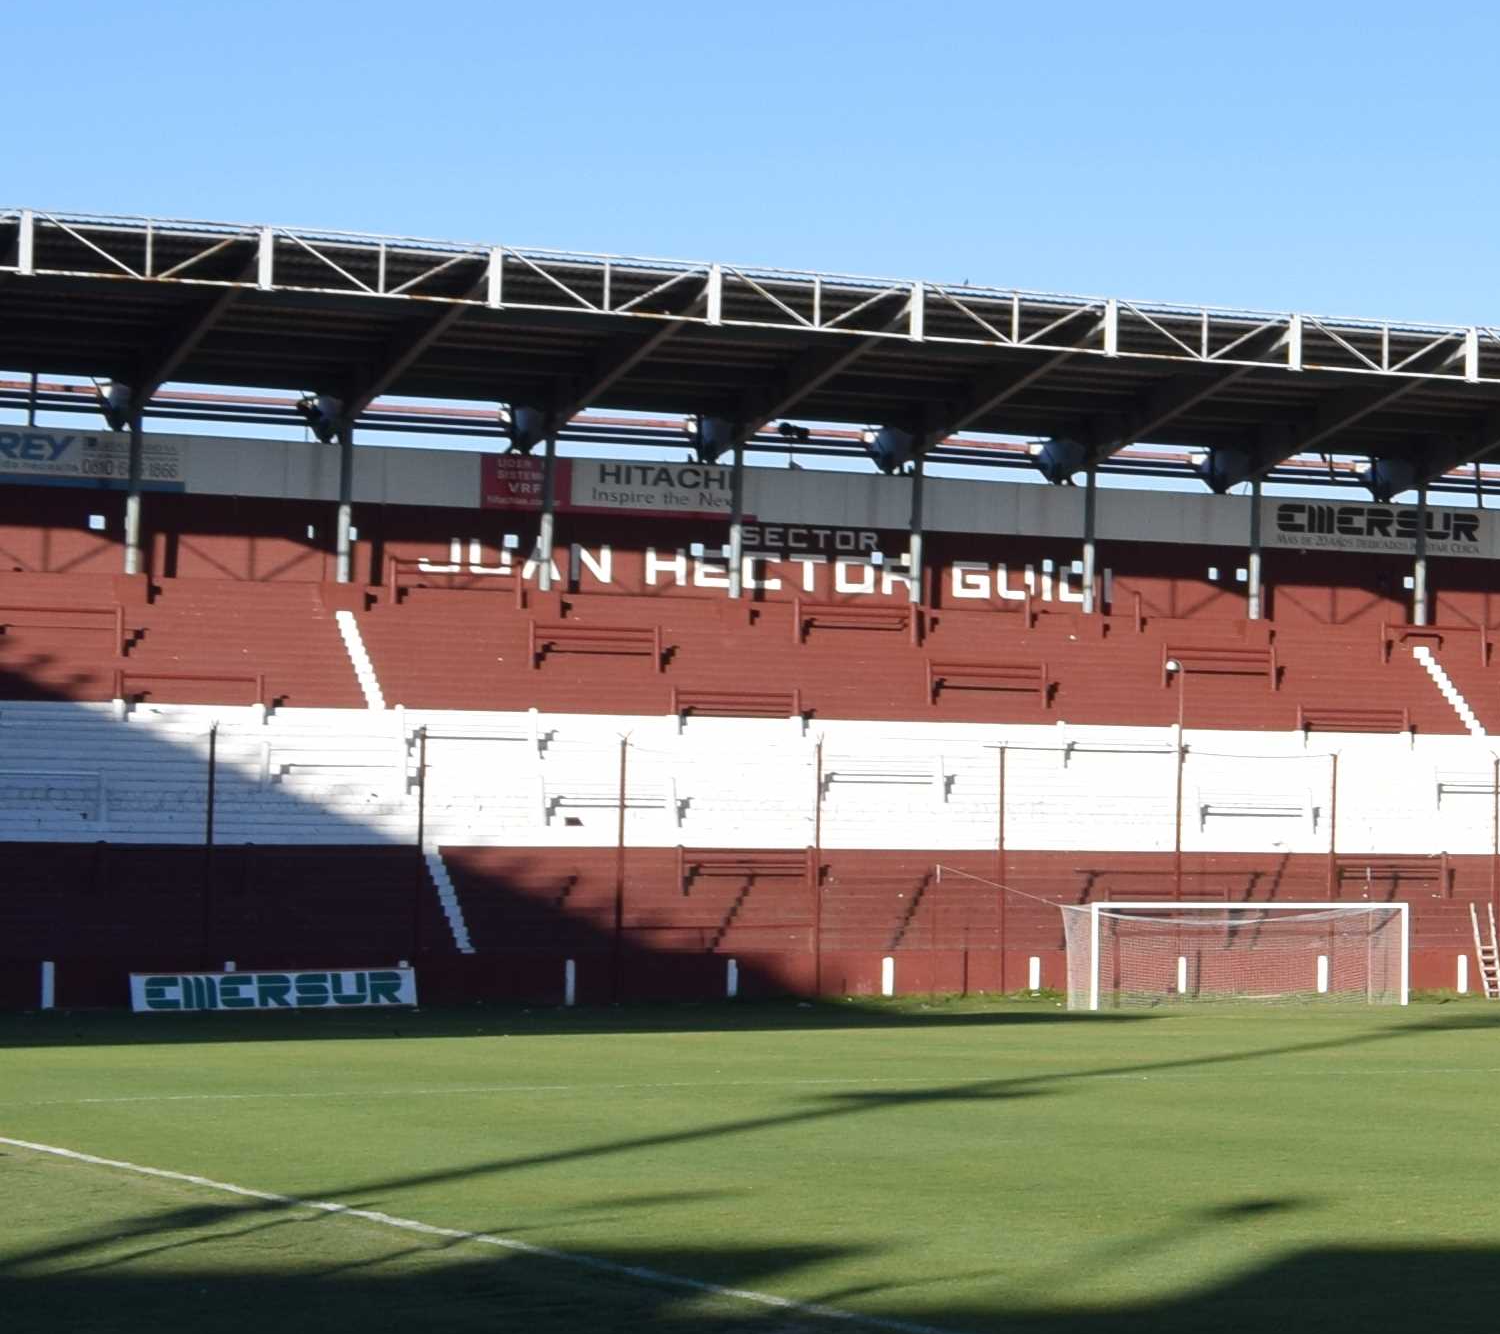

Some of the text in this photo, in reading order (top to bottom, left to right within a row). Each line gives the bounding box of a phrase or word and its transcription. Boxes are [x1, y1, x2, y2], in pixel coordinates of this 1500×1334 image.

[600, 464, 734, 490] HITACHI
[592, 488, 654, 506] Inspire
[664, 493, 689, 505] the
[741, 526, 878, 550] SECTOR
[1277, 503, 1480, 542] EMERSUR
[418, 537, 612, 584] JUAN
[645, 545, 916, 596] HECTOR
[145, 970, 403, 1010] EMERSUR
